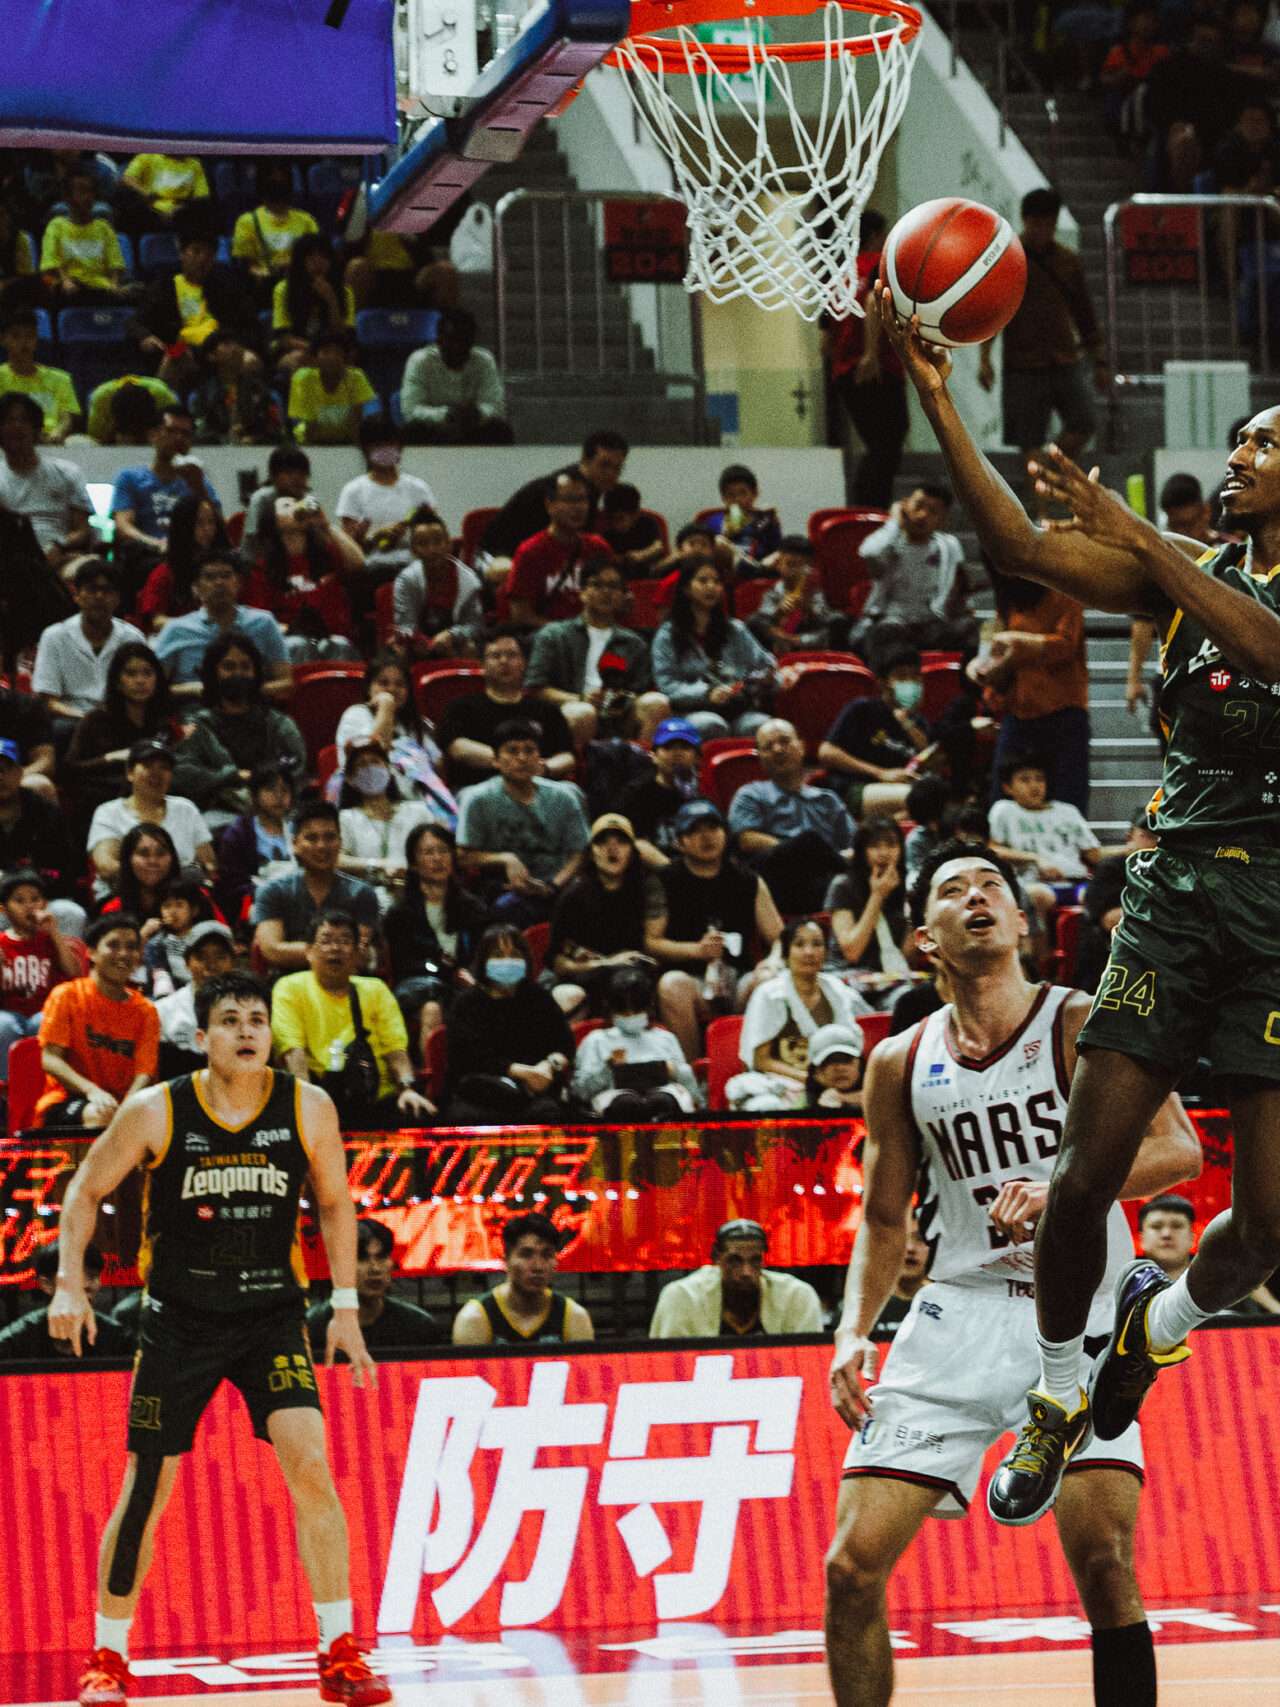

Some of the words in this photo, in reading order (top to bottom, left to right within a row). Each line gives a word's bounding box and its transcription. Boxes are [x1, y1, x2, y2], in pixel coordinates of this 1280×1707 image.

[1099, 964, 1156, 1017] 24
[926, 1089, 1063, 1182] MARS
[181, 1162, 289, 1200] Leopards
[269, 1368, 317, 1394] ONE
[376, 1354, 803, 1634] 防守
